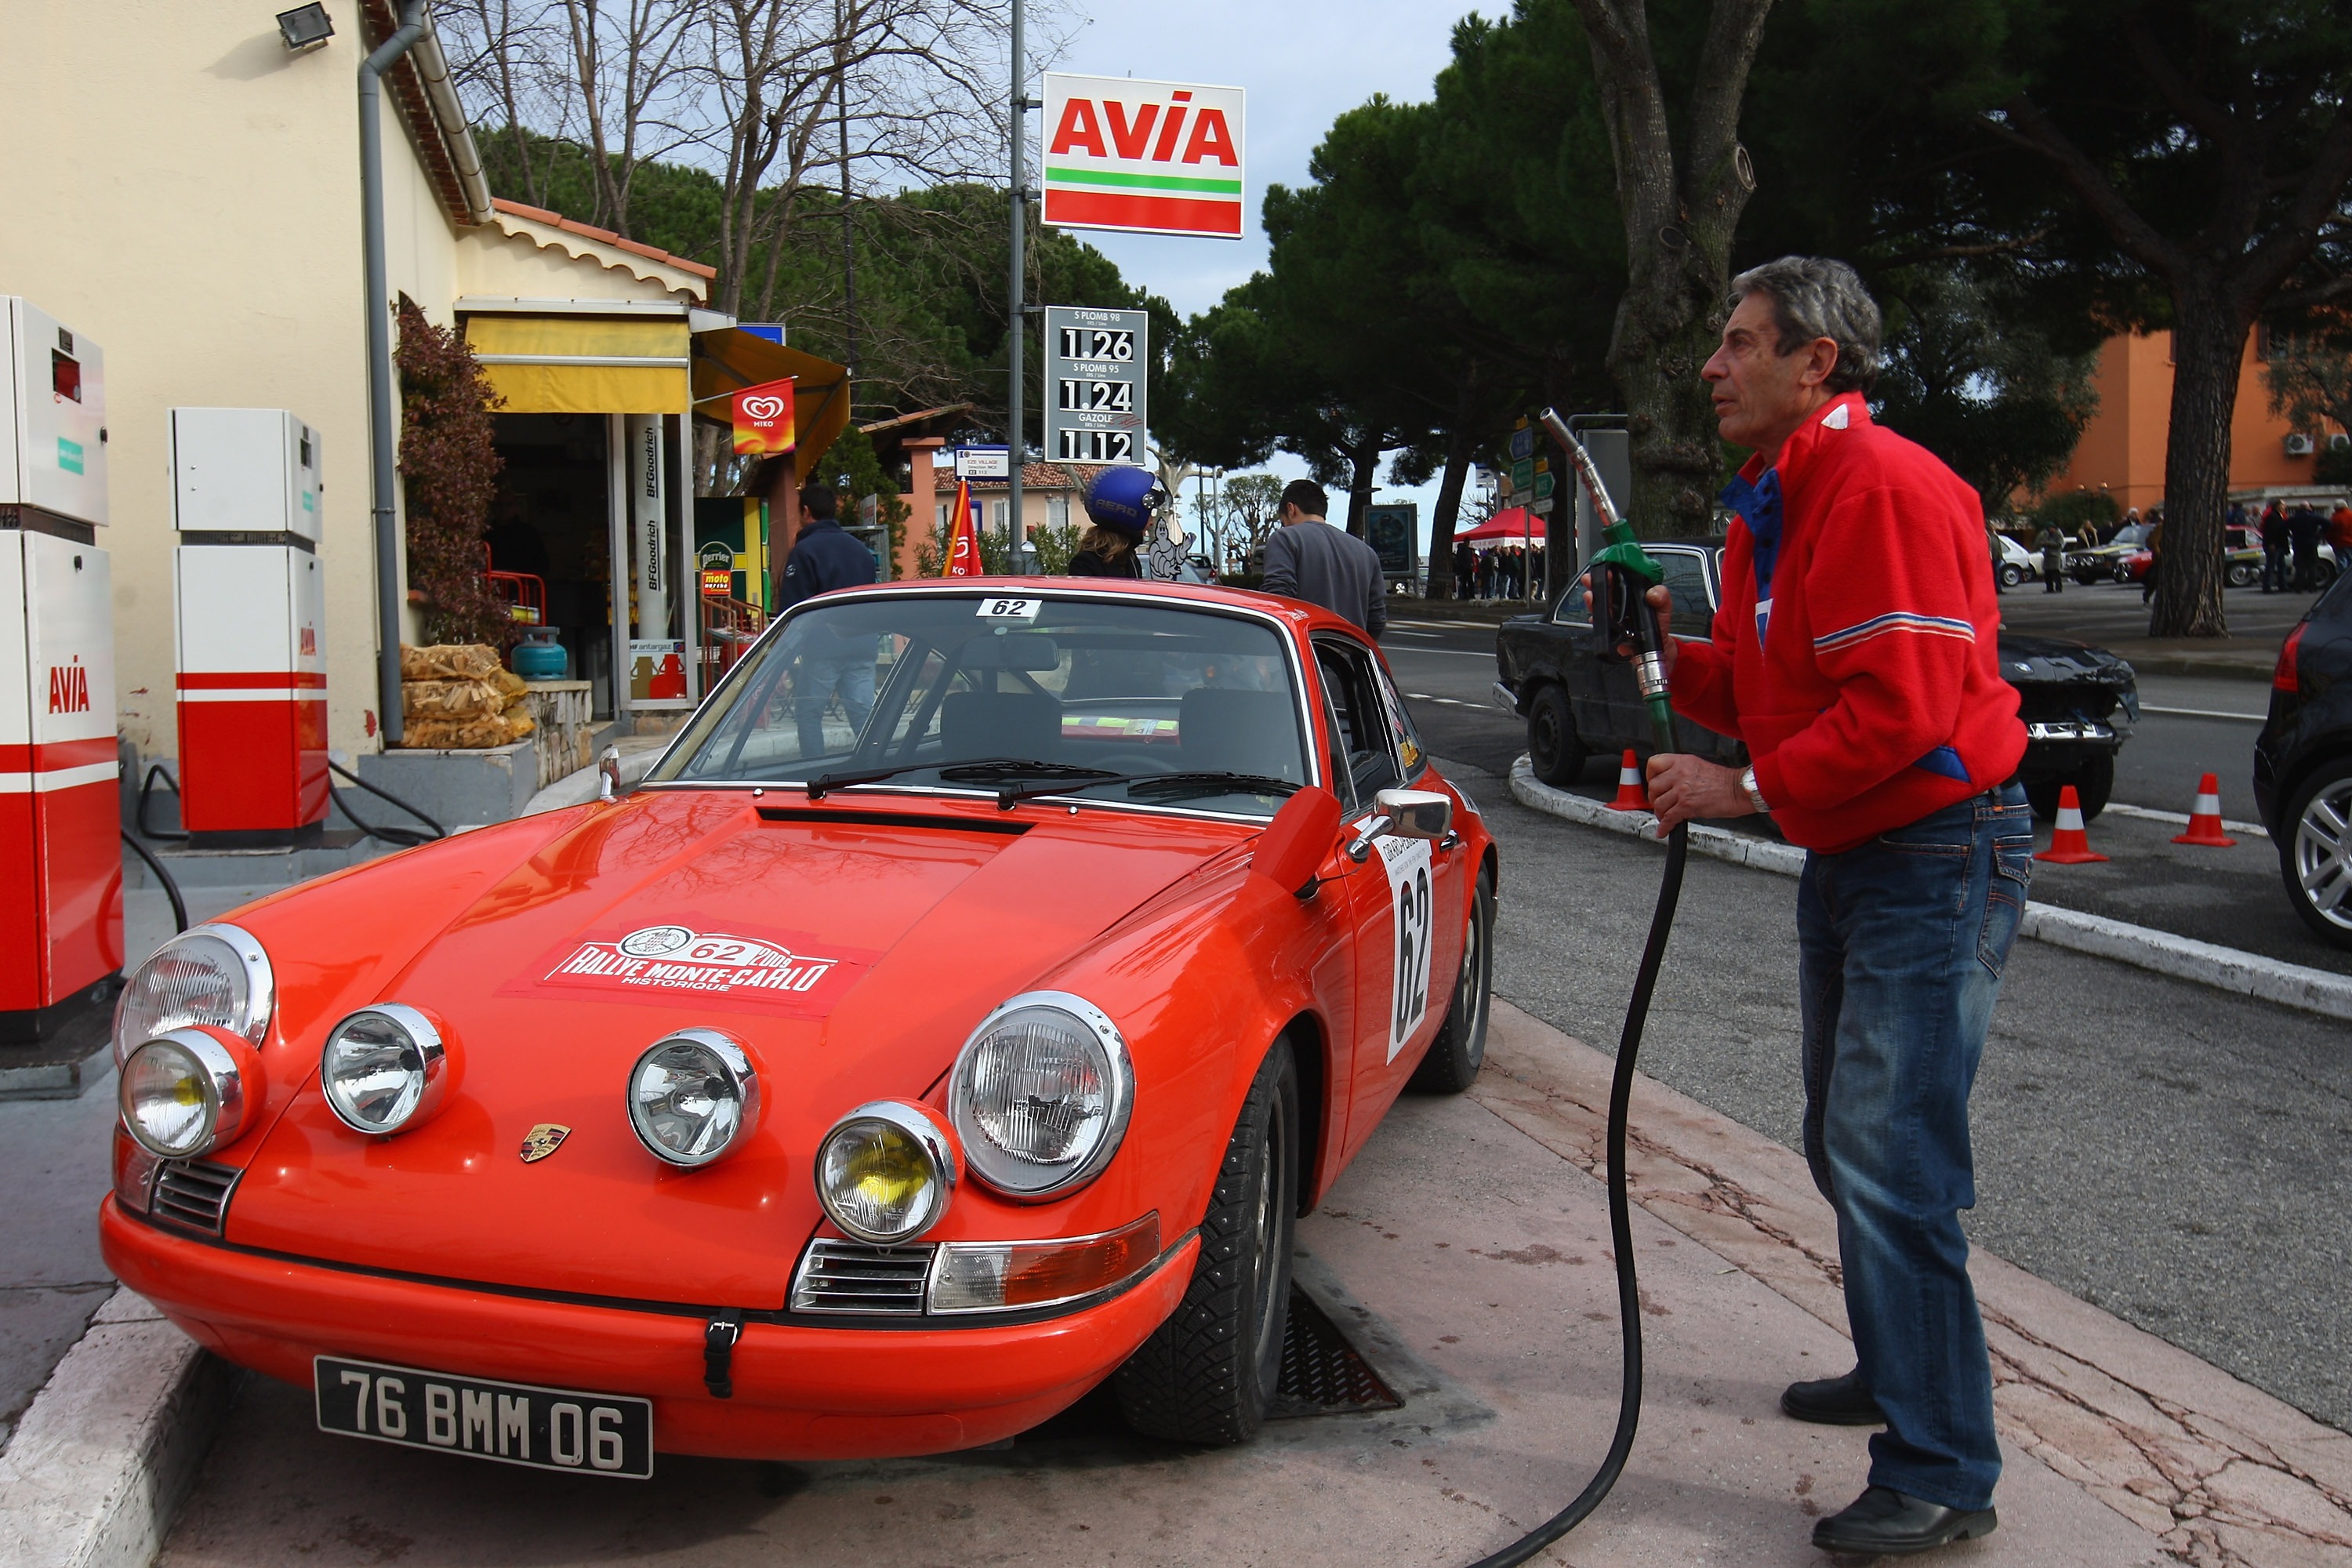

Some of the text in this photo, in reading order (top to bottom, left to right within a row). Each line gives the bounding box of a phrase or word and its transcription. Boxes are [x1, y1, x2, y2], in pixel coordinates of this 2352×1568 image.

[1074, 310, 1120, 321] S PLOMB 98
[1066, 330, 1132, 361] 1.26
[1073, 363, 1120, 373] S PLOMB 95
[1065, 381, 1132, 411] 1.24
[1065, 431, 1131, 461] 1.12
[646, 427, 656, 498] BFGoodrich
[647, 520, 658, 591] BFGoodrich
[706, 573, 729, 583] moto
[991, 600, 1027, 615] 62
[638, 643, 672, 652] antargaz
[561, 946, 829, 993] RALLYE MONTE-CARLO
[690, 942, 746, 961] 62
[748, 947, 793, 968] 2009
[1396, 866, 1428, 1044] 62
[621, 977, 732, 992] HISTORIQUE
[340, 1370, 623, 1471] 76 BMM 06
